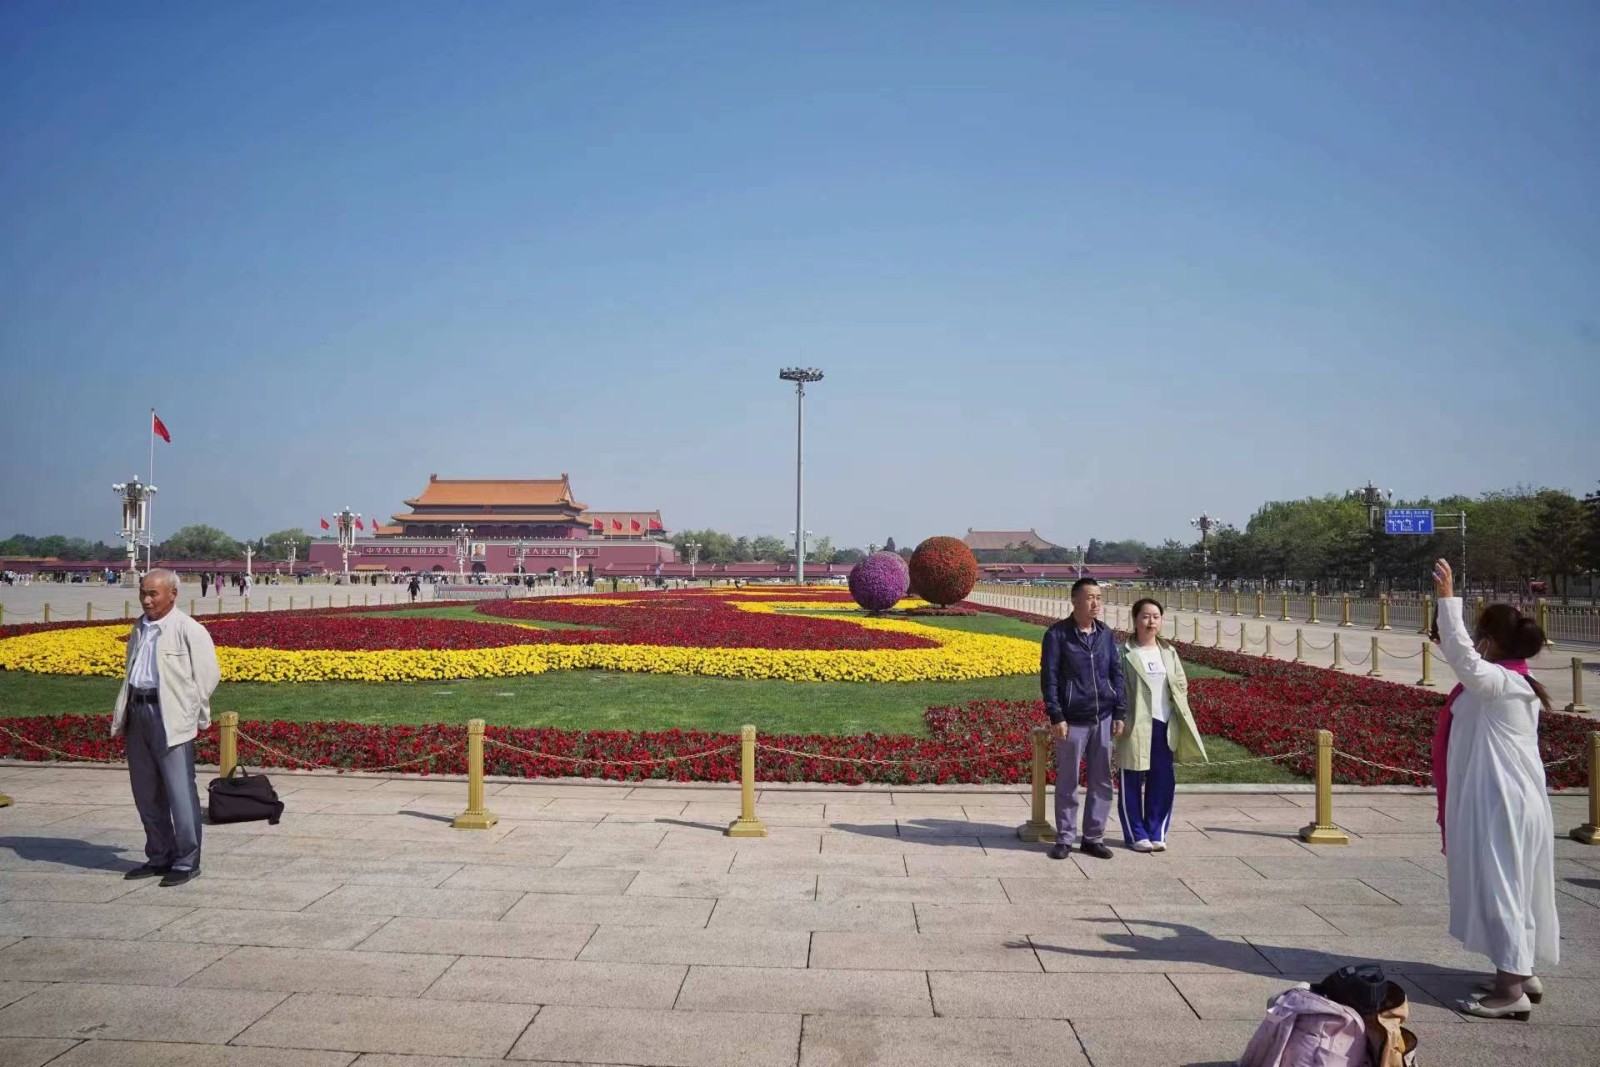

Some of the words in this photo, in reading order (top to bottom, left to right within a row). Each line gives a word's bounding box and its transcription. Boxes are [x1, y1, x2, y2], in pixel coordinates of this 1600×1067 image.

[366, 547, 445, 555] 中华人民共和国万岁
